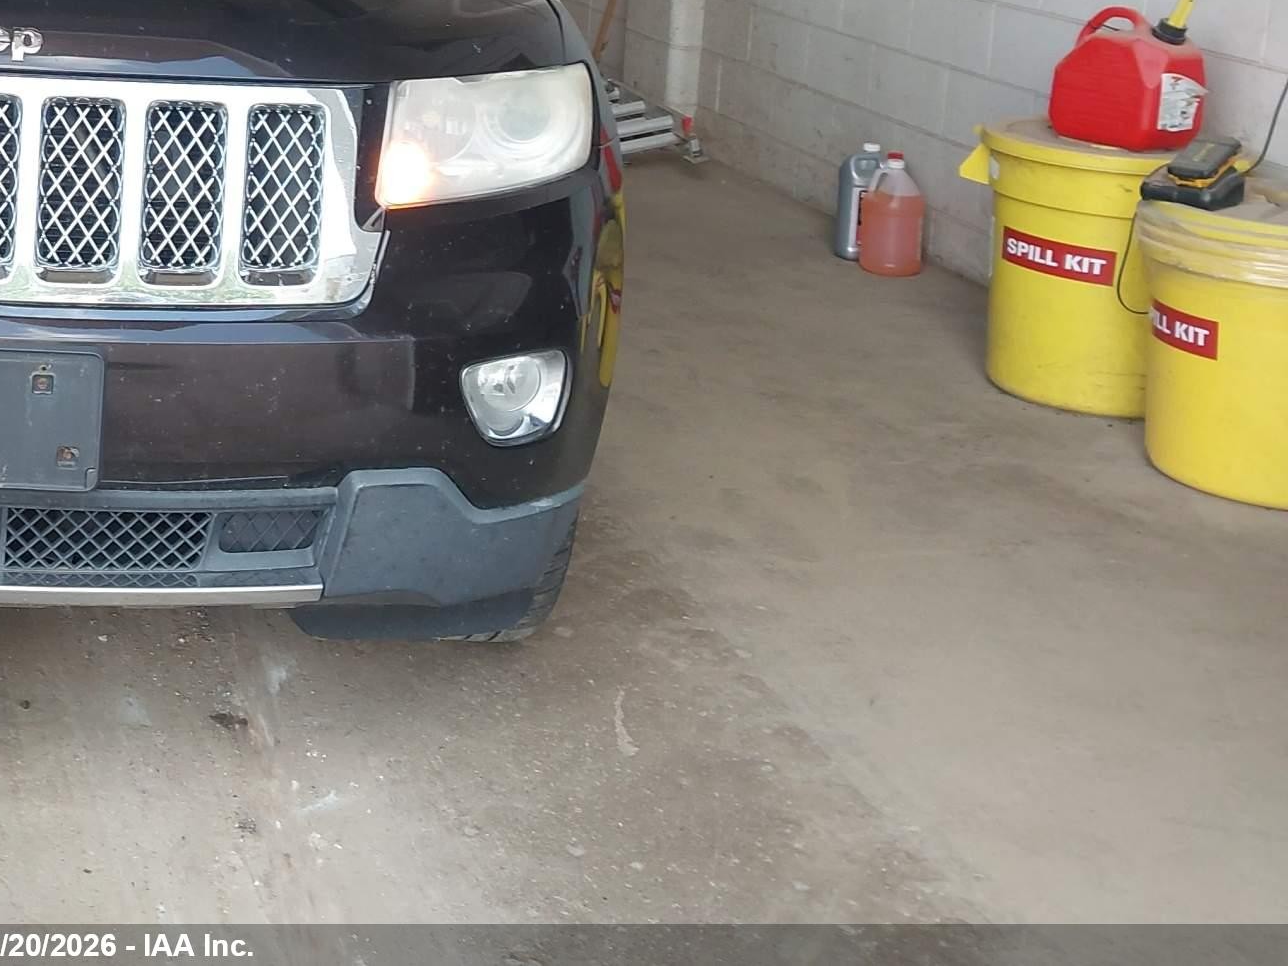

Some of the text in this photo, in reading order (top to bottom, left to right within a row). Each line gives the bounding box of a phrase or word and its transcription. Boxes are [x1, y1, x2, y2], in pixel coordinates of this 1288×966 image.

[1006, 237, 1107, 275] SPILL KIT
[1150, 305, 1210, 347] ILL KIT
